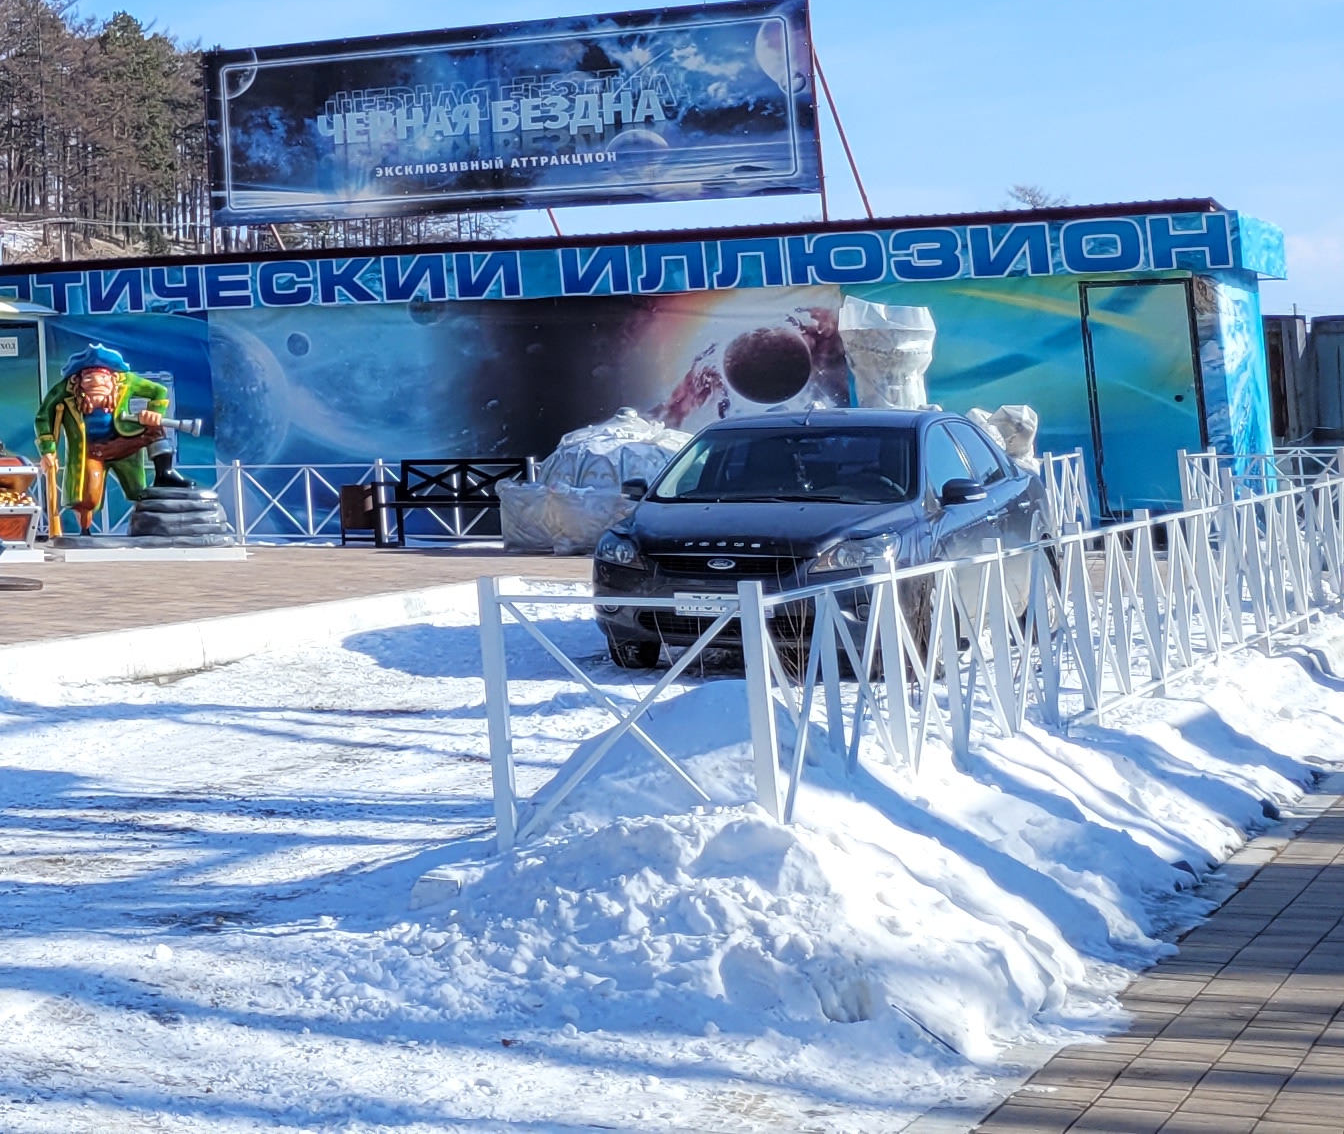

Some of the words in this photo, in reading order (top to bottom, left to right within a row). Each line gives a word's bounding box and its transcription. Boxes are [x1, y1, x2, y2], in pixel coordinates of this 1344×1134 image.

[317, 103, 480, 144] ЧЕРНАЯ
[492, 89, 667, 135] БЕЗДНА
[375, 156, 504, 177] ЭКСКЛЮЗИВНЫЙ
[511, 151, 617, 168] АТТРАКЦИОН
[559, 214, 1234, 296] ИЛЛЮЗИОН
